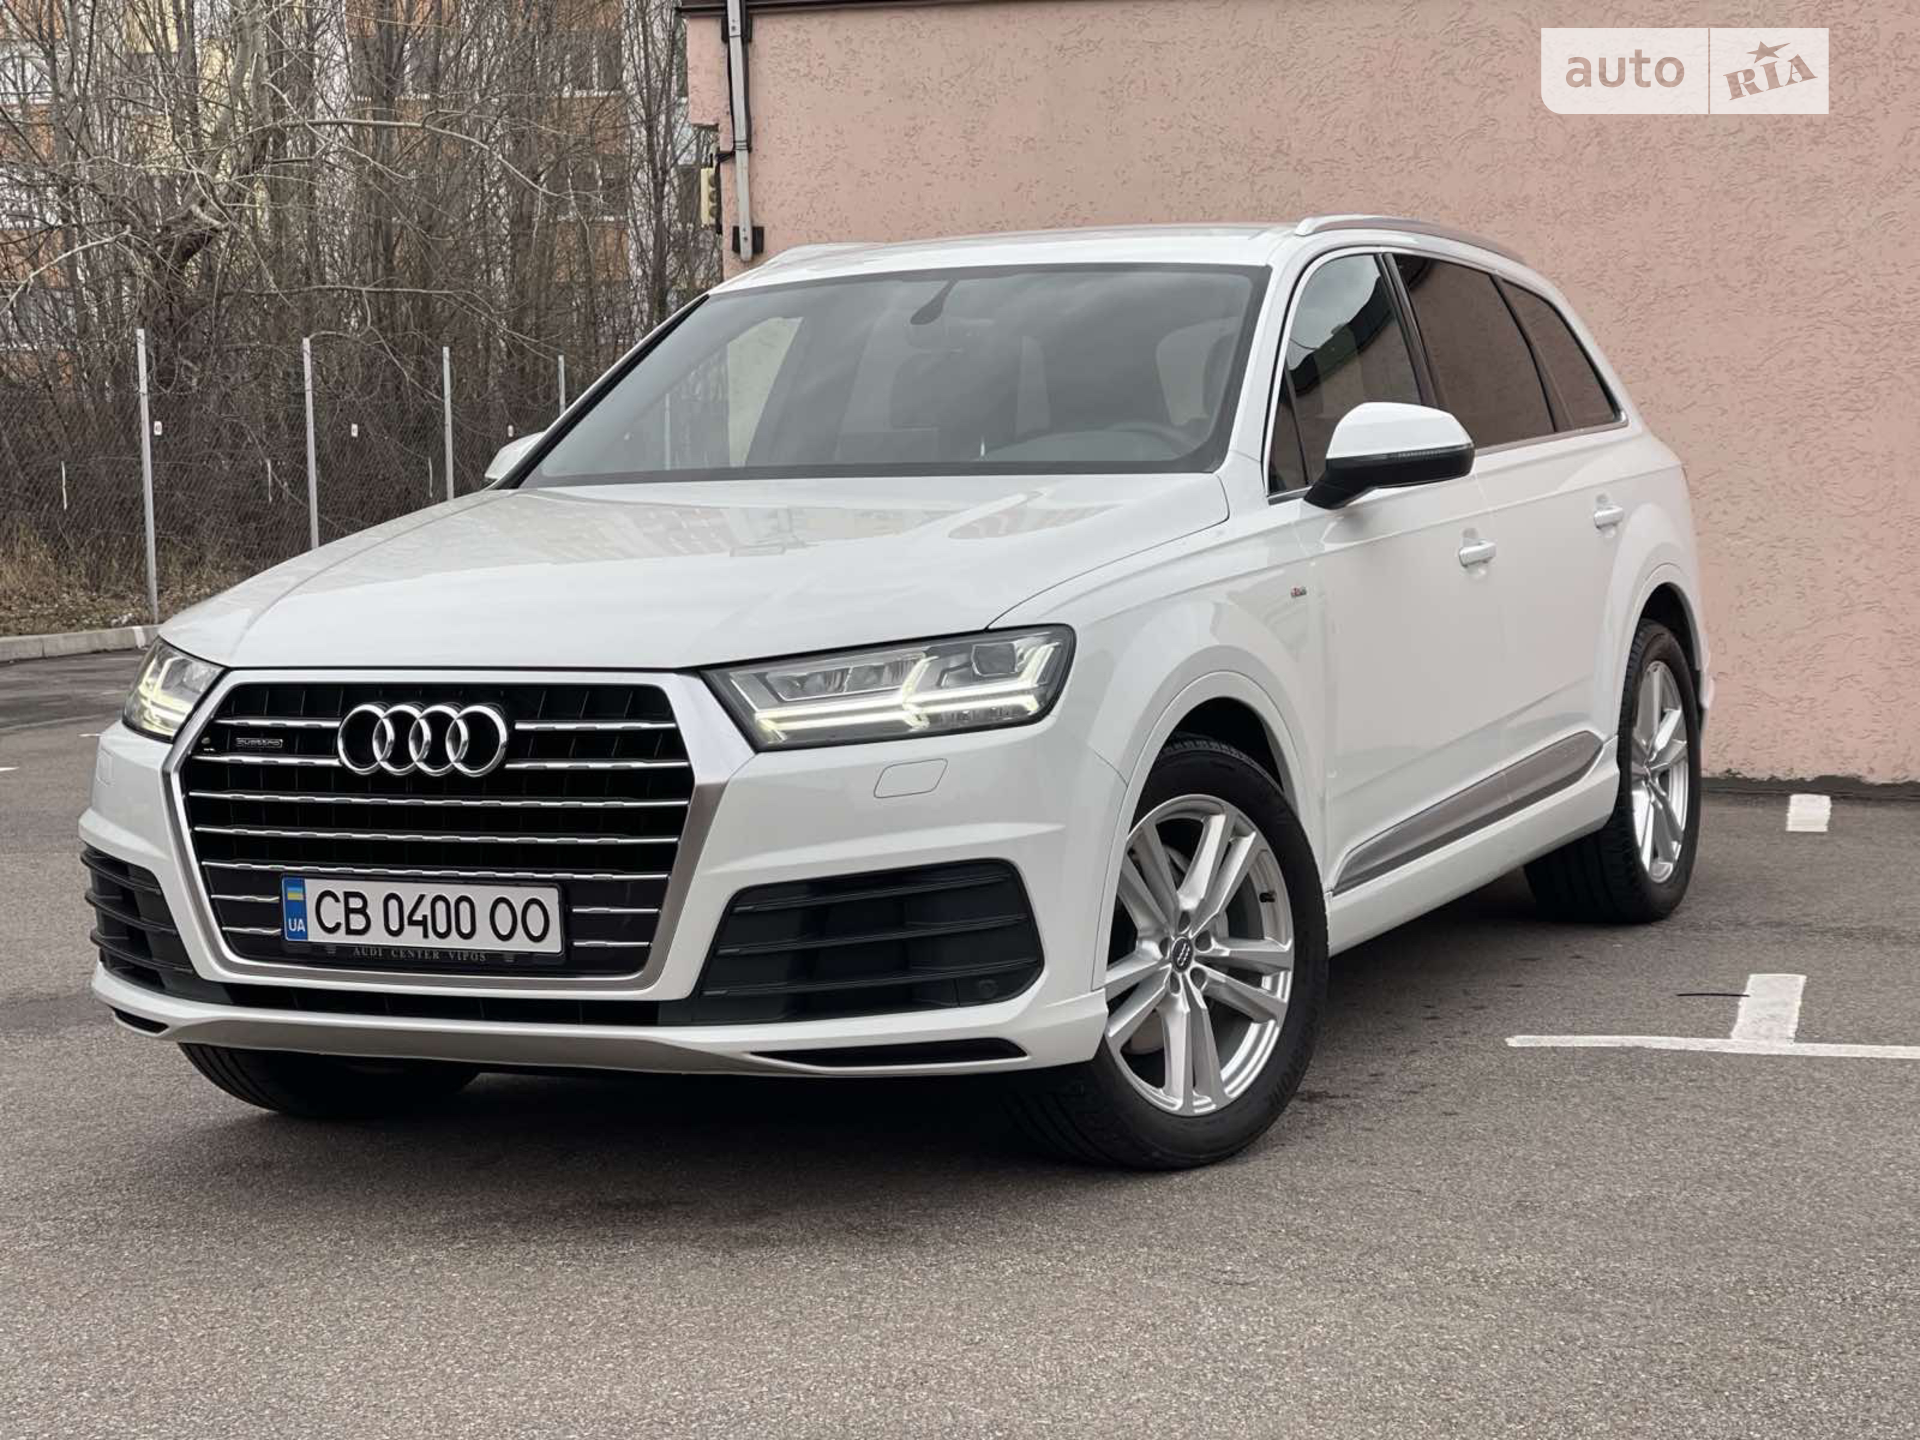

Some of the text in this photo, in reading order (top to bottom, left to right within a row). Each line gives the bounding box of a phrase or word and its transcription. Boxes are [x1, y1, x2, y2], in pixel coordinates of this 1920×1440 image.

[315, 889, 371, 936] CB
[382, 892, 477, 940] 0400
[288, 918, 306, 932] UA
[353, 946, 383, 957] AUDI
[391, 948, 440, 960] CENTER
